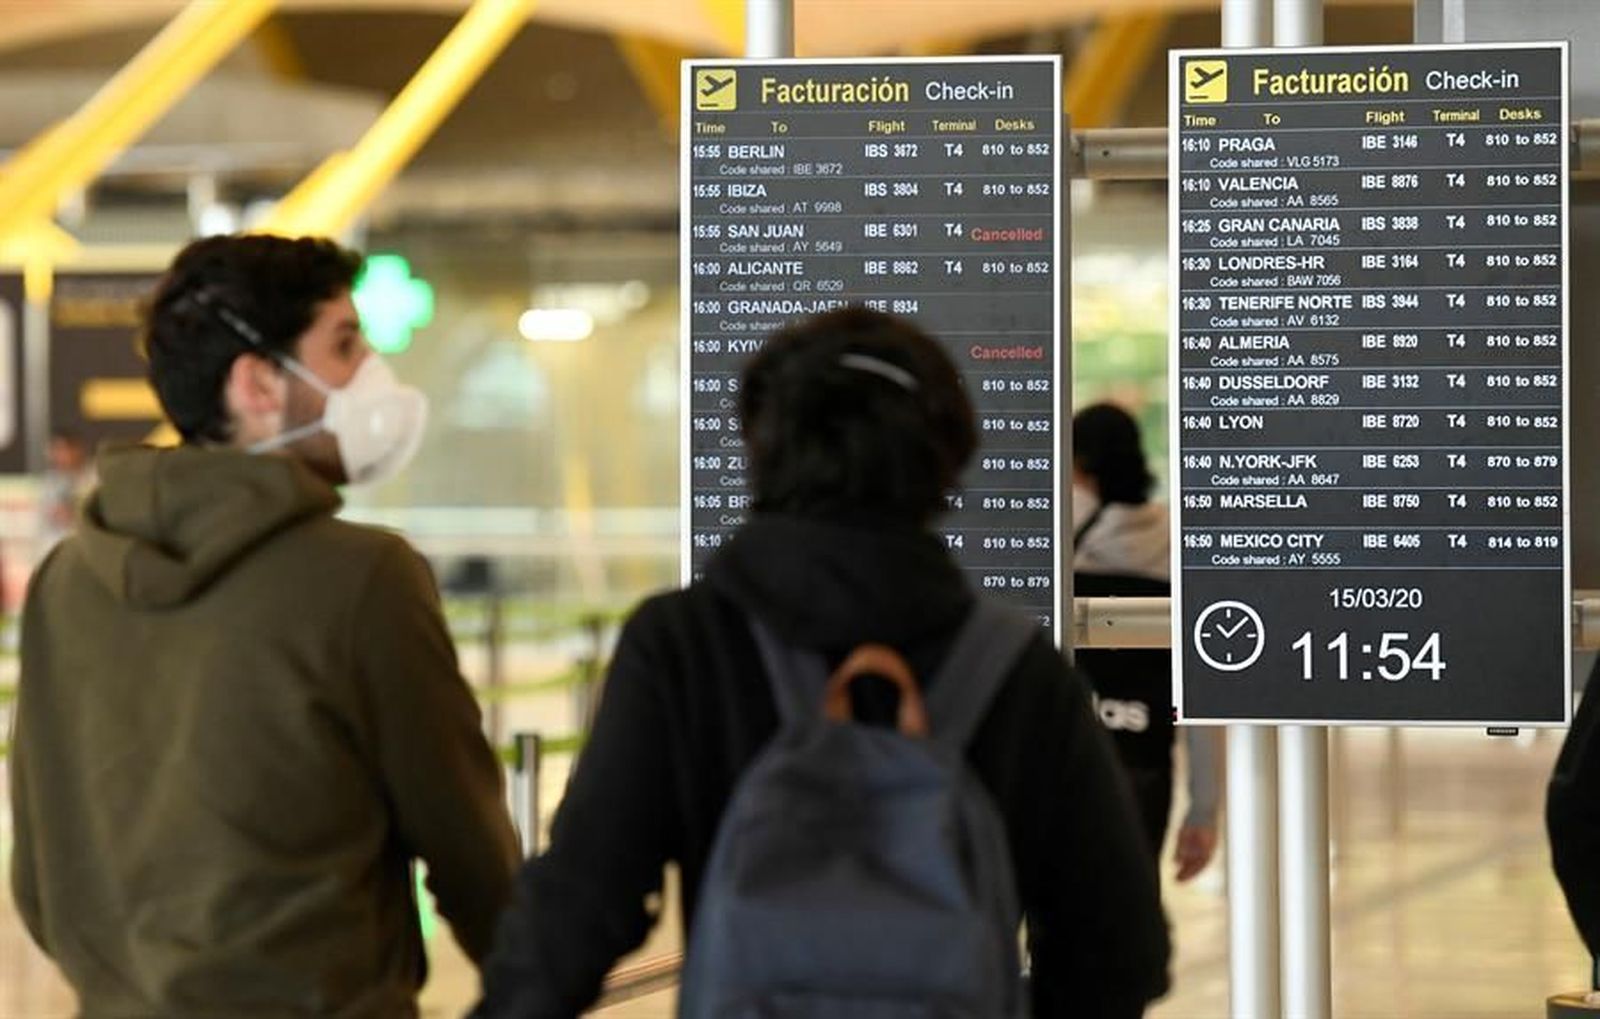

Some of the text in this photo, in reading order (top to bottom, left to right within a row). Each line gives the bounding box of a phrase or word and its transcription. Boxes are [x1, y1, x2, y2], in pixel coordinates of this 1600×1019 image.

[1253, 65, 1519, 95] Facturación Check-in
[761, 76, 1014, 104] Facturación Check-in
[1183, 108, 1542, 127] Time To Flight Terminal Desks
[695, 118, 1035, 135] Time To Flight Terminal Desks
[1182, 132, 1557, 152] 16:10 PRAGA IBE 3146 T4 810 to 852
[693, 144, 721, 158] 15:55
[728, 145, 785, 159] BERLIN
[864, 143, 888, 158] IBS
[944, 143, 964, 157] T4
[982, 143, 1005, 156] 810
[1010, 144, 1024, 156] to
[1026, 143, 1050, 155] 852
[719, 164, 747, 176] Code
[749, 164, 785, 175] shared
[793, 163, 812, 175] IBE
[693, 184, 721, 198] 15:55
[727, 183, 767, 198] IBIZA
[864, 182, 888, 197] IBS
[943, 182, 963, 196] T4
[982, 184, 1006, 195] 810
[1009, 184, 1024, 195] to
[1026, 183, 1050, 195] 852
[1182, 173, 1557, 192] 16:10 VALENCIA IBE 8876 T4 810 to 852
[719, 203, 747, 214] Code
[749, 203, 785, 214] shared
[792, 201, 808, 213] AT
[1182, 214, 1557, 233] 16:25 GRAN CANARIA IBS 3838 T4 810 to 852
[693, 224, 721, 238] 15:55
[727, 224, 760, 239] SAN
[762, 224, 804, 239] JUAN
[864, 223, 888, 238] IBE
[944, 223, 963, 237] T4
[971, 227, 1043, 242] Cancelled
[1209, 234, 1341, 248] Code shared LA 7045
[693, 262, 721, 276] 16:00
[727, 261, 804, 276] ALICANTE
[864, 260, 887, 275] IBE
[944, 260, 963, 274] T4
[982, 261, 1006, 274] 810
[1009, 262, 1024, 274] to
[1026, 261, 1049, 274] 852
[693, 300, 721, 314] 16:00
[1182, 293, 1557, 311] 16:30 TENERIFE NORTE IBS 3944 T4 810 to 852
[693, 339, 1043, 360] 16:00 KYIV Cancelled
[1182, 413, 1558, 430] 16:40 LYON IBE 8720 T4 810 to 852
[1183, 454, 1558, 469] 16:40 N.YORK-JFK IBE 6253 T4 870 to 879
[1210, 473, 1340, 486] Code shared AA 8647
[1183, 494, 1558, 509] 16:50 MARSELLA IBE 8750 T4 810 to 852
[693, 533, 721, 547] 16:10
[945, 534, 964, 548] T4
[983, 537, 1007, 549] 810
[1010, 537, 1025, 549] to
[1026, 536, 1050, 549] 852
[1183, 533, 1559, 549] 16:50 MEXICO CITY IBE 6405 T4 814 to 819
[1211, 552, 1341, 565] Code shared AY 5555
[983, 575, 1050, 588] 870 to 879
[1329, 588, 1423, 609] 15/03/20
[1292, 631, 1447, 681] 11:54
